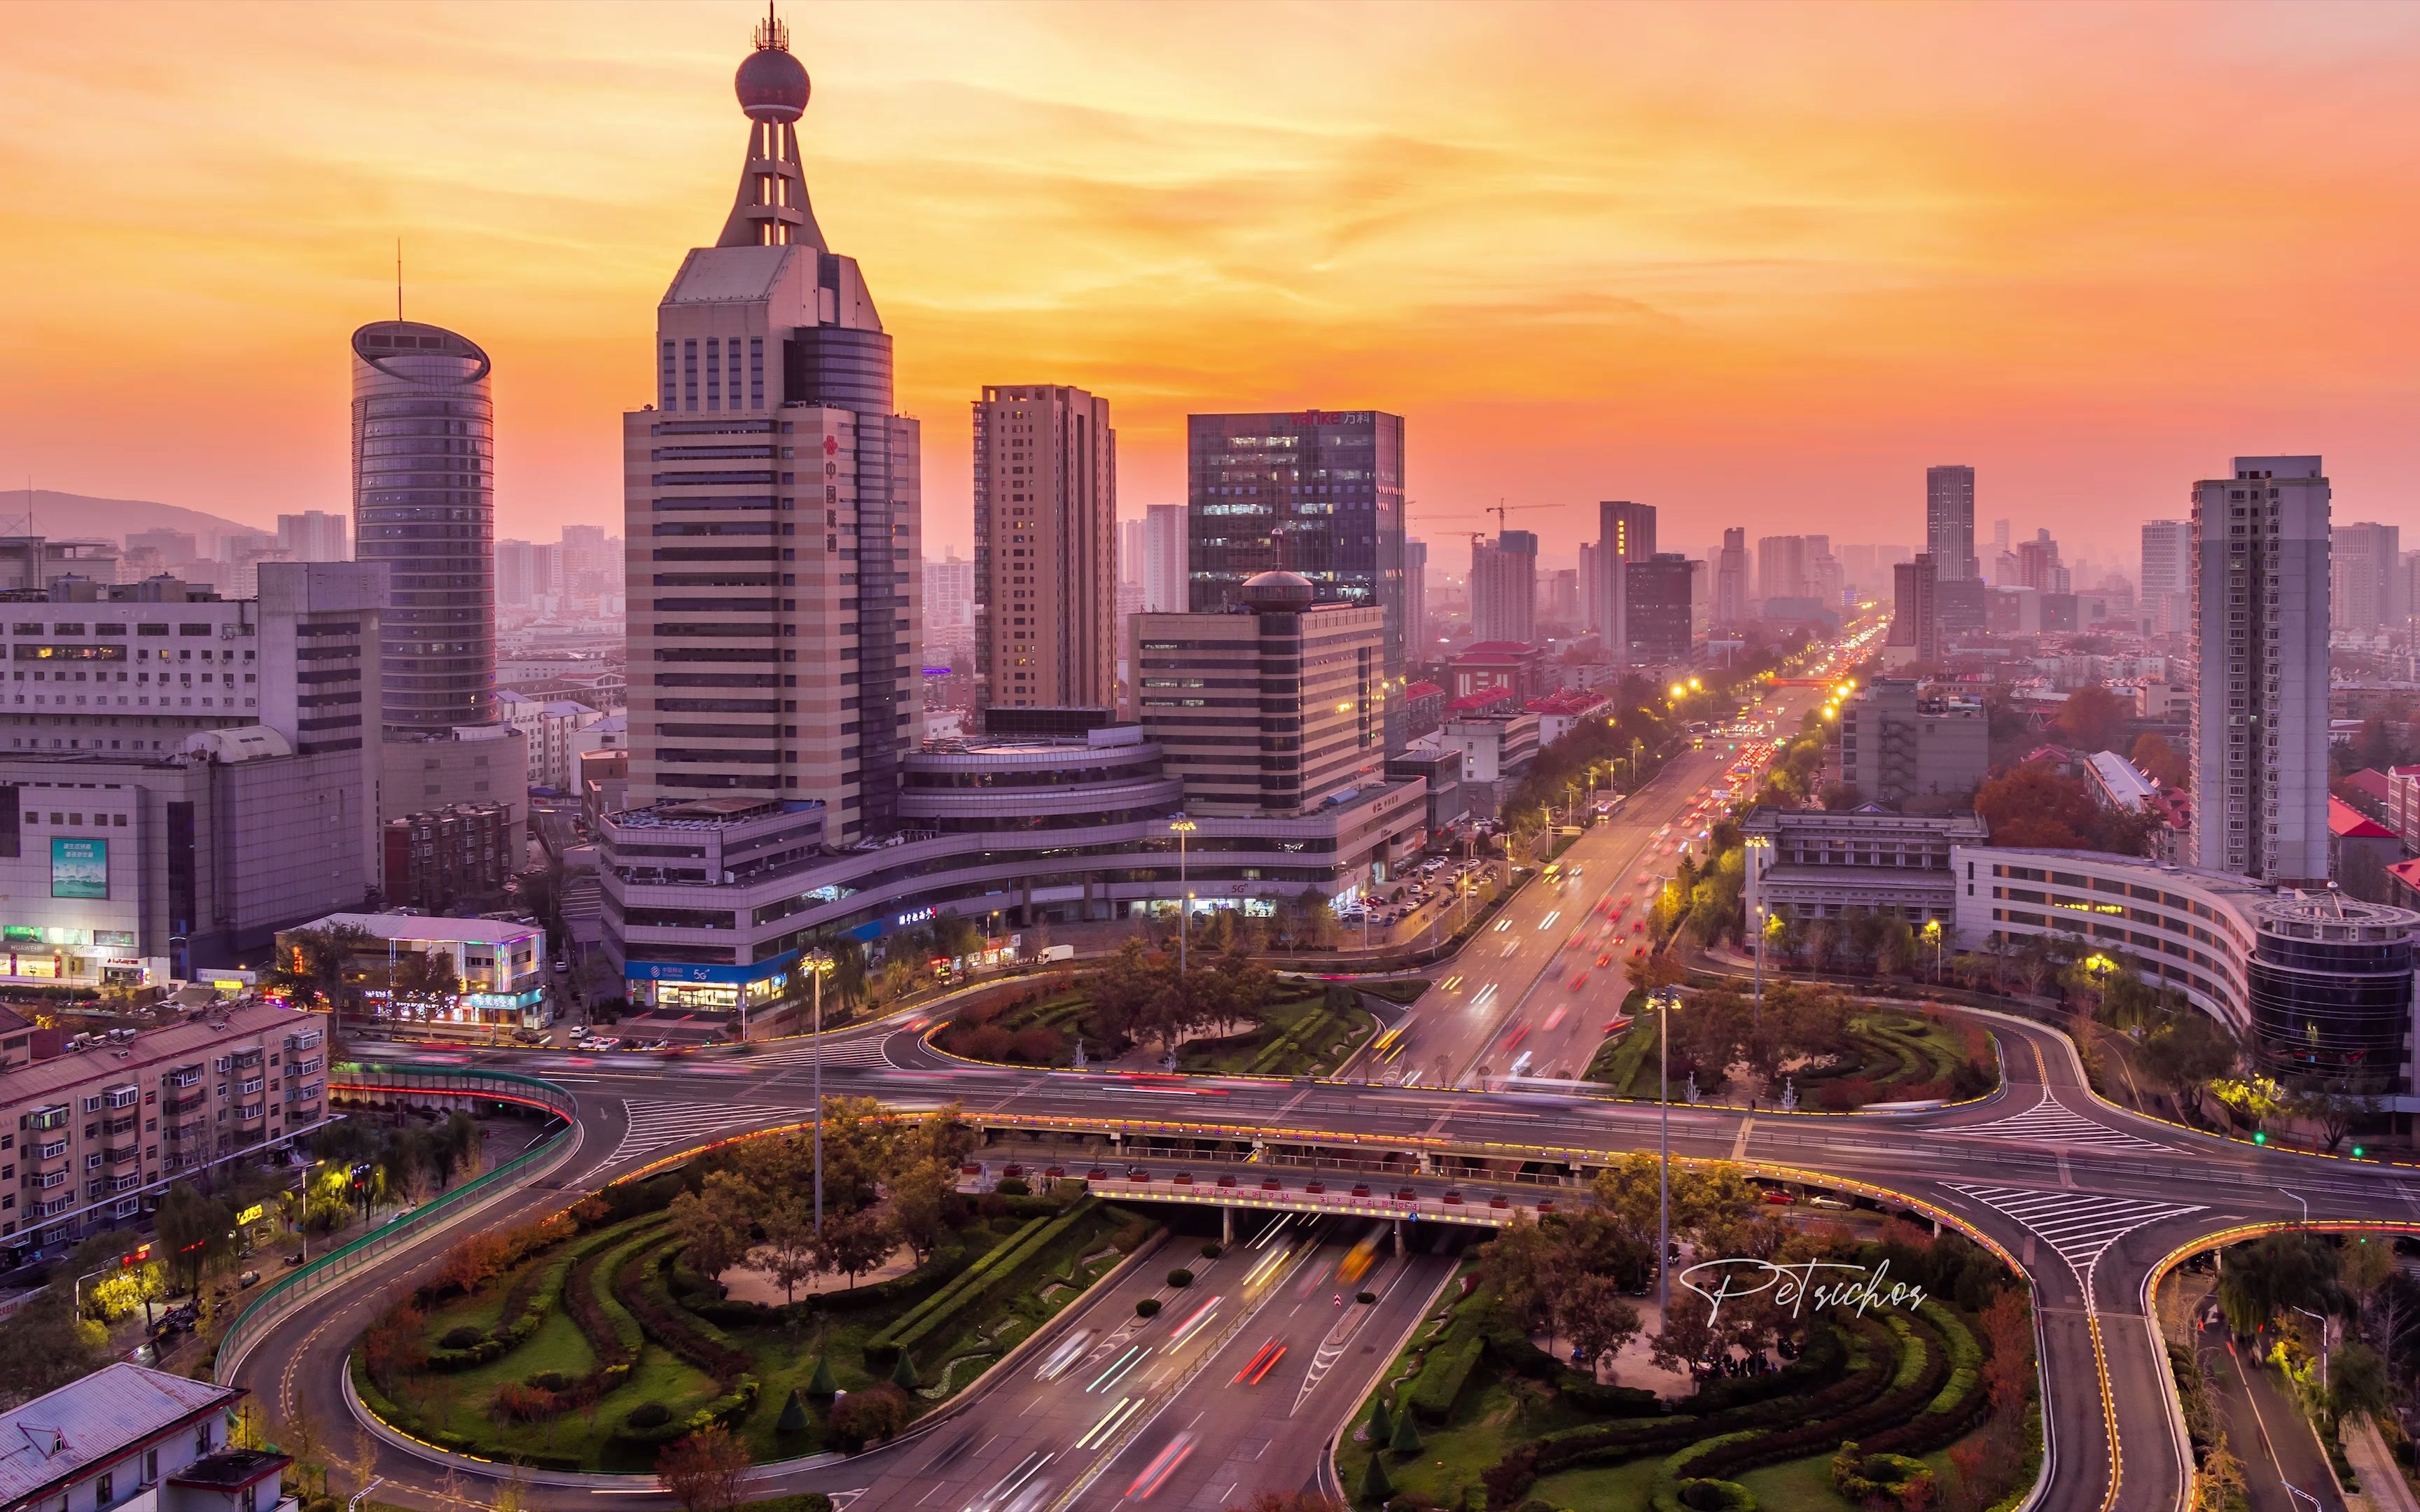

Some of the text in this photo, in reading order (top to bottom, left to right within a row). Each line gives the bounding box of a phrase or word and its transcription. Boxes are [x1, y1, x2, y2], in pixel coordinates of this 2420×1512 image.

[1343, 411, 1370, 425] 万科
[826, 461, 837, 552] 中国联通
[693, 968, 707, 980] 5G
[1193, 1187, 1420, 1210] 坚定不移听党话 矢志不渝跟党走
